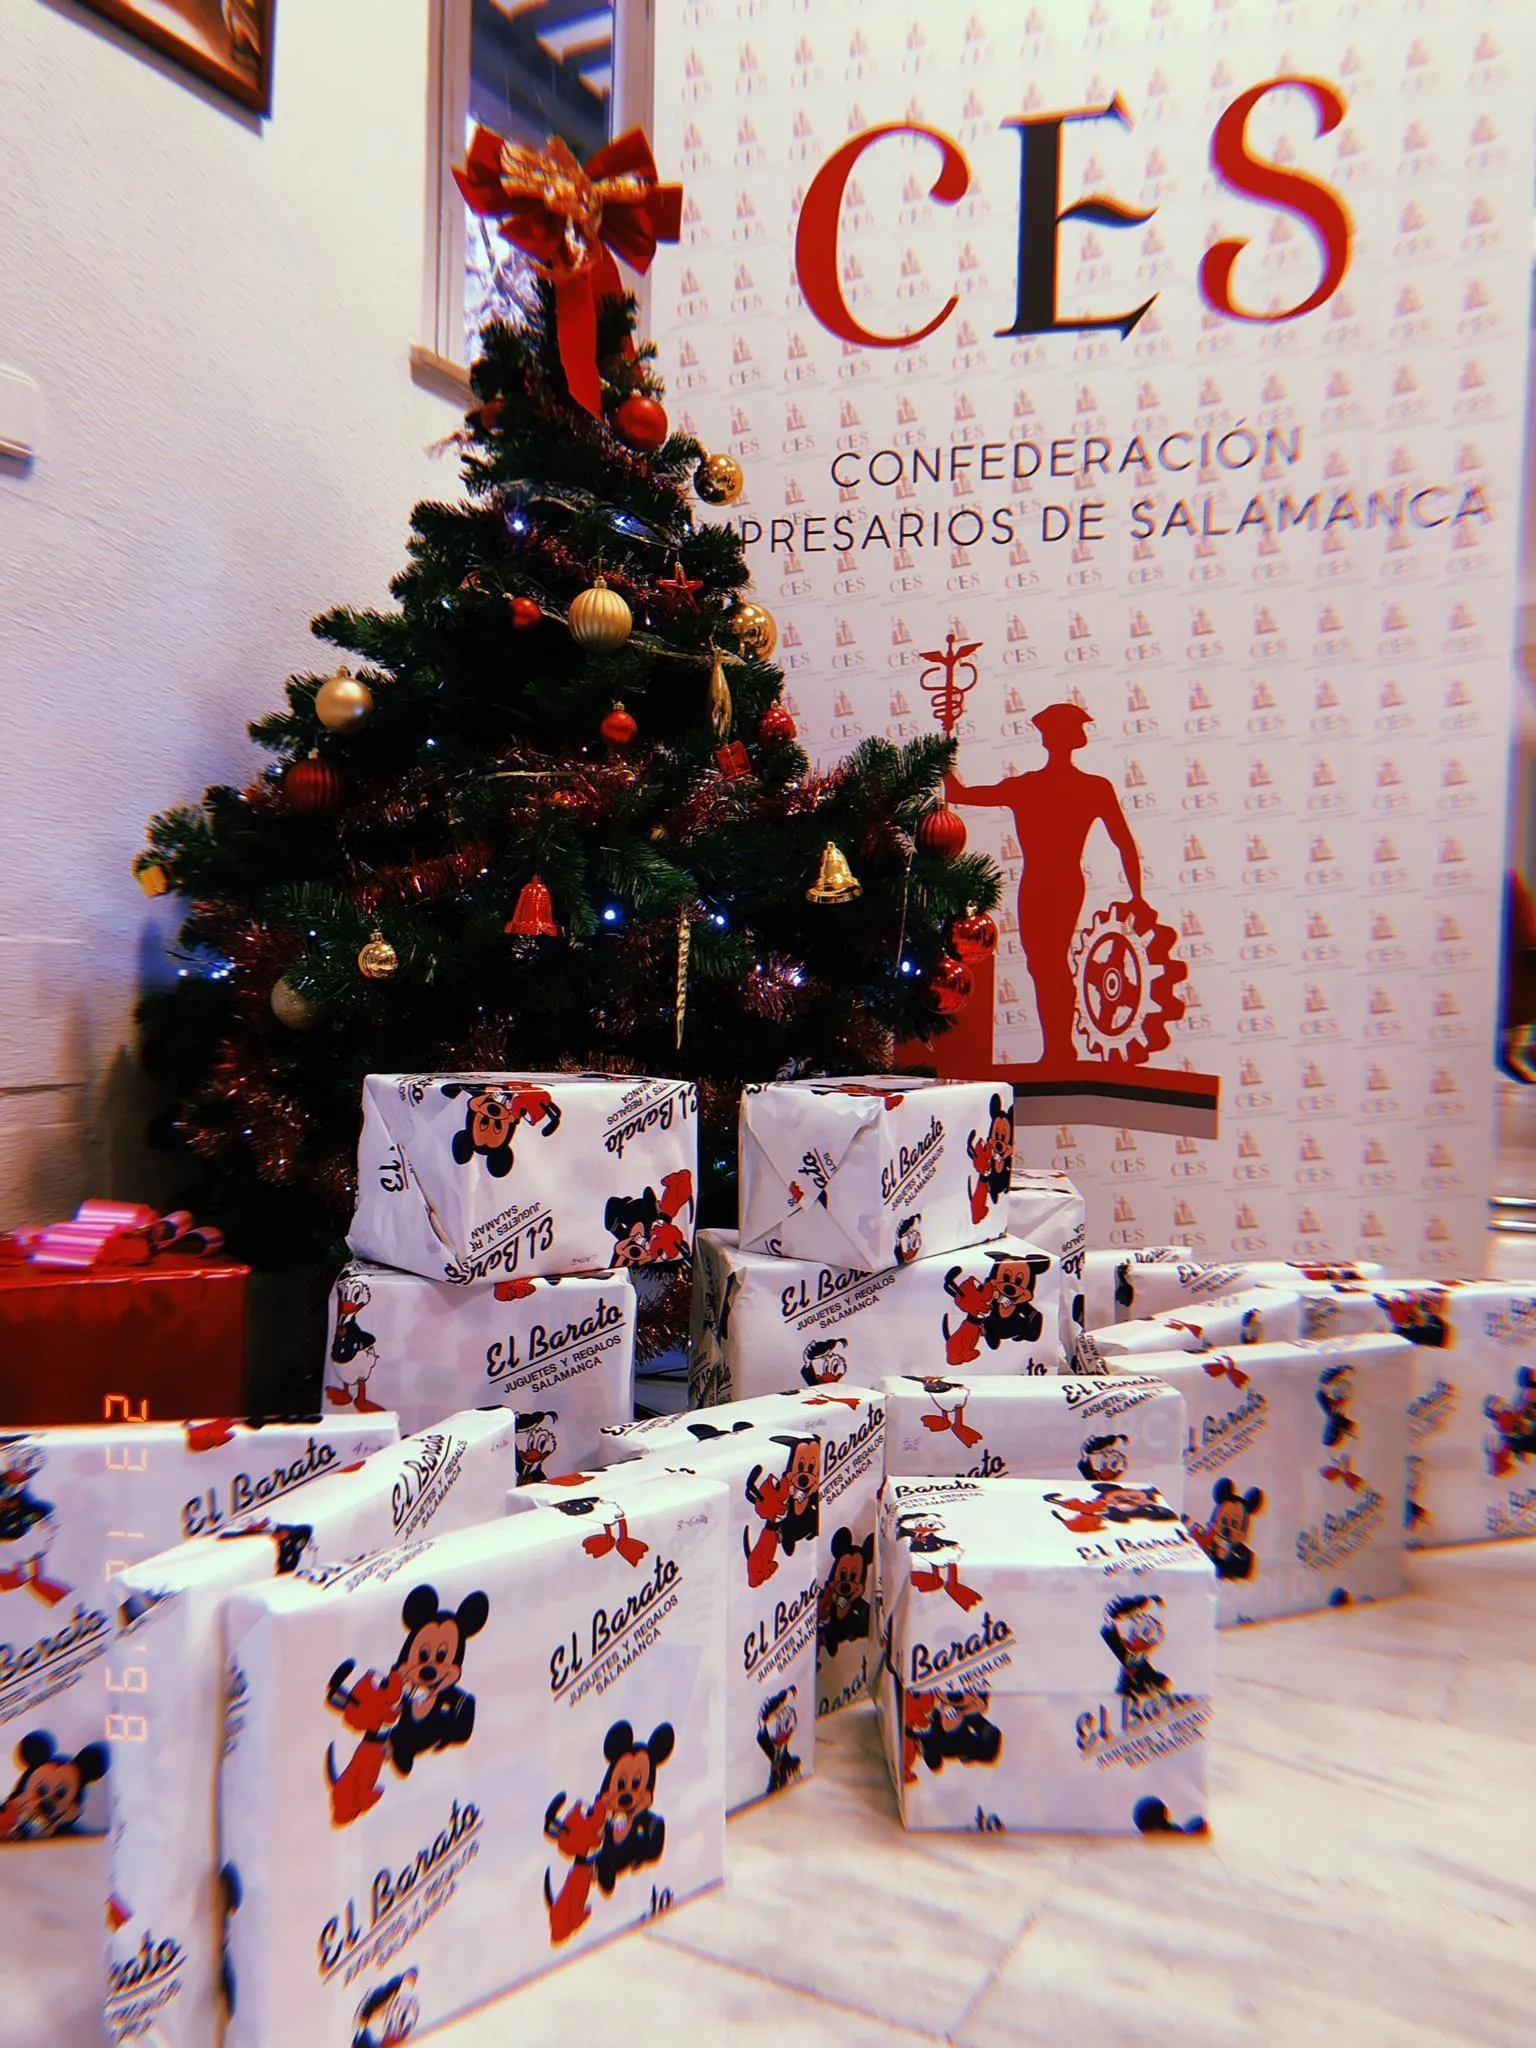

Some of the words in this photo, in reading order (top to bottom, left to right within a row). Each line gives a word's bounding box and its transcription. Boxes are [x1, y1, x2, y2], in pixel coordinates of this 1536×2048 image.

[795, 73, 1354, 349] CES
[783, 363, 815, 382] CES
[838, 359, 871, 378] CES
[895, 355, 928, 374] CES
[729, 367, 761, 385] CES
[951, 426, 985, 444] CES
[1010, 422, 1044, 441] CES
[1070, 419, 1106, 438] CES
[728, 439, 759, 457] CES
[781, 436, 813, 454] CES
[836, 433, 869, 451] CES
[893, 429, 926, 448] CES
[830, 417, 1303, 488] CONFEDERACIÓN
[741, 508, 1015, 554] PRESARIOS
[1042, 503, 1106, 542] DE
[1131, 485, 1494, 540] SALAMANCA
[1006, 572, 1040, 590] CES
[1066, 570, 1101, 588] CES
[1127, 568, 1163, 586] CES
[1188, 565, 1226, 584] CES
[1251, 563, 1290, 582] CES
[778, 581, 810, 598] CES
[833, 578, 866, 596] CES
[890, 576, 923, 594] CES
[947, 574, 981, 592] CES
[888, 649, 921, 667] CES
[1004, 646, 1038, 664] CES
[1064, 644, 1099, 663] CES
[1124, 643, 1160, 662] CES
[1186, 642, 1223, 660] CES
[1249, 640, 1287, 659] CES
[832, 651, 864, 668] CES
[831, 723, 863, 740] CES
[887, 721, 919, 739] CES
[1002, 720, 1036, 737] CES
[1122, 718, 1158, 736] CES
[1184, 717, 1221, 736] CES
[1246, 716, 1284, 735] CES
[1120, 792, 1156, 810] CES
[1182, 792, 1218, 811] CES
[1244, 792, 1282, 811] CES
[1180, 867, 1216, 885] CES
[1242, 868, 1279, 886] CES
[1178, 941, 1213, 959] CES
[1240, 943, 1276, 960] CES
[996, 1009, 1029, 1026] CES
[1176, 1015, 1211, 1032] CES
[1238, 1017, 1274, 1034] CES
[1235, 1090, 1272, 1107] CES
[606, 1098, 643, 1125] REGALOS
[605, 1097, 674, 1159] Barato
[881, 1159, 897, 1199] El
[899, 1114, 944, 1180] Barato
[1051, 1154, 1085, 1170] CES
[1111, 1157, 1146, 1173] CES
[1172, 1160, 1207, 1176] CES
[1233, 1163, 1270, 1180] CES
[904, 1166, 937, 1206] SALAMANCA
[471, 1205, 519, 1238] SALAMAN
[497, 1202, 541, 1236] JUGUETES
[526, 1206, 553, 1259] El
[1109, 1228, 1144, 1244] CES
[1170, 1232, 1205, 1248] CES
[1231, 1236, 1268, 1252] CES
[781, 1279, 810, 1317] El
[796, 1302, 843, 1331] JUGUETES
[853, 1274, 896, 1301] REGALOS
[819, 1295, 880, 1329] SALAMANCA
[486, 1335, 519, 1379] El
[529, 1297, 624, 1361] Barato
[503, 1364, 559, 1394] JUGUETES
[560, 1357, 569, 1367] Y
[571, 1334, 623, 1362] REGALOS
[531, 1356, 603, 1394] SALAMANCA
[1062, 1383, 1093, 1405] El
[824, 1402, 885, 1477] Barato
[853, 1434, 884, 1469] REGALOS
[181, 1486, 224, 1539] El
[230, 1436, 337, 1517] Barato
[825, 1459, 873, 1506] SALAMANCA
[895, 1480, 980, 1499] Barato
[392, 1472, 414, 1528] El
[1076, 1544, 1113, 1562] El
[550, 1631, 583, 1693] El
[591, 1554, 680, 1659] Barato
[744, 1620, 768, 1671] El
[775, 1579, 818, 1641] Bara
[568, 1650, 621, 1708] JUGUETES
[633, 1594, 679, 1642] REGALOS
[911, 1611, 1014, 1683] Barato
[595, 1627, 662, 1696] SALAMANCA
[757, 1635, 796, 1683] JUGUETES
[1075, 1703, 1112, 1752] El
[318, 1896, 362, 1977] El
[371, 1796, 481, 1930] Barato
